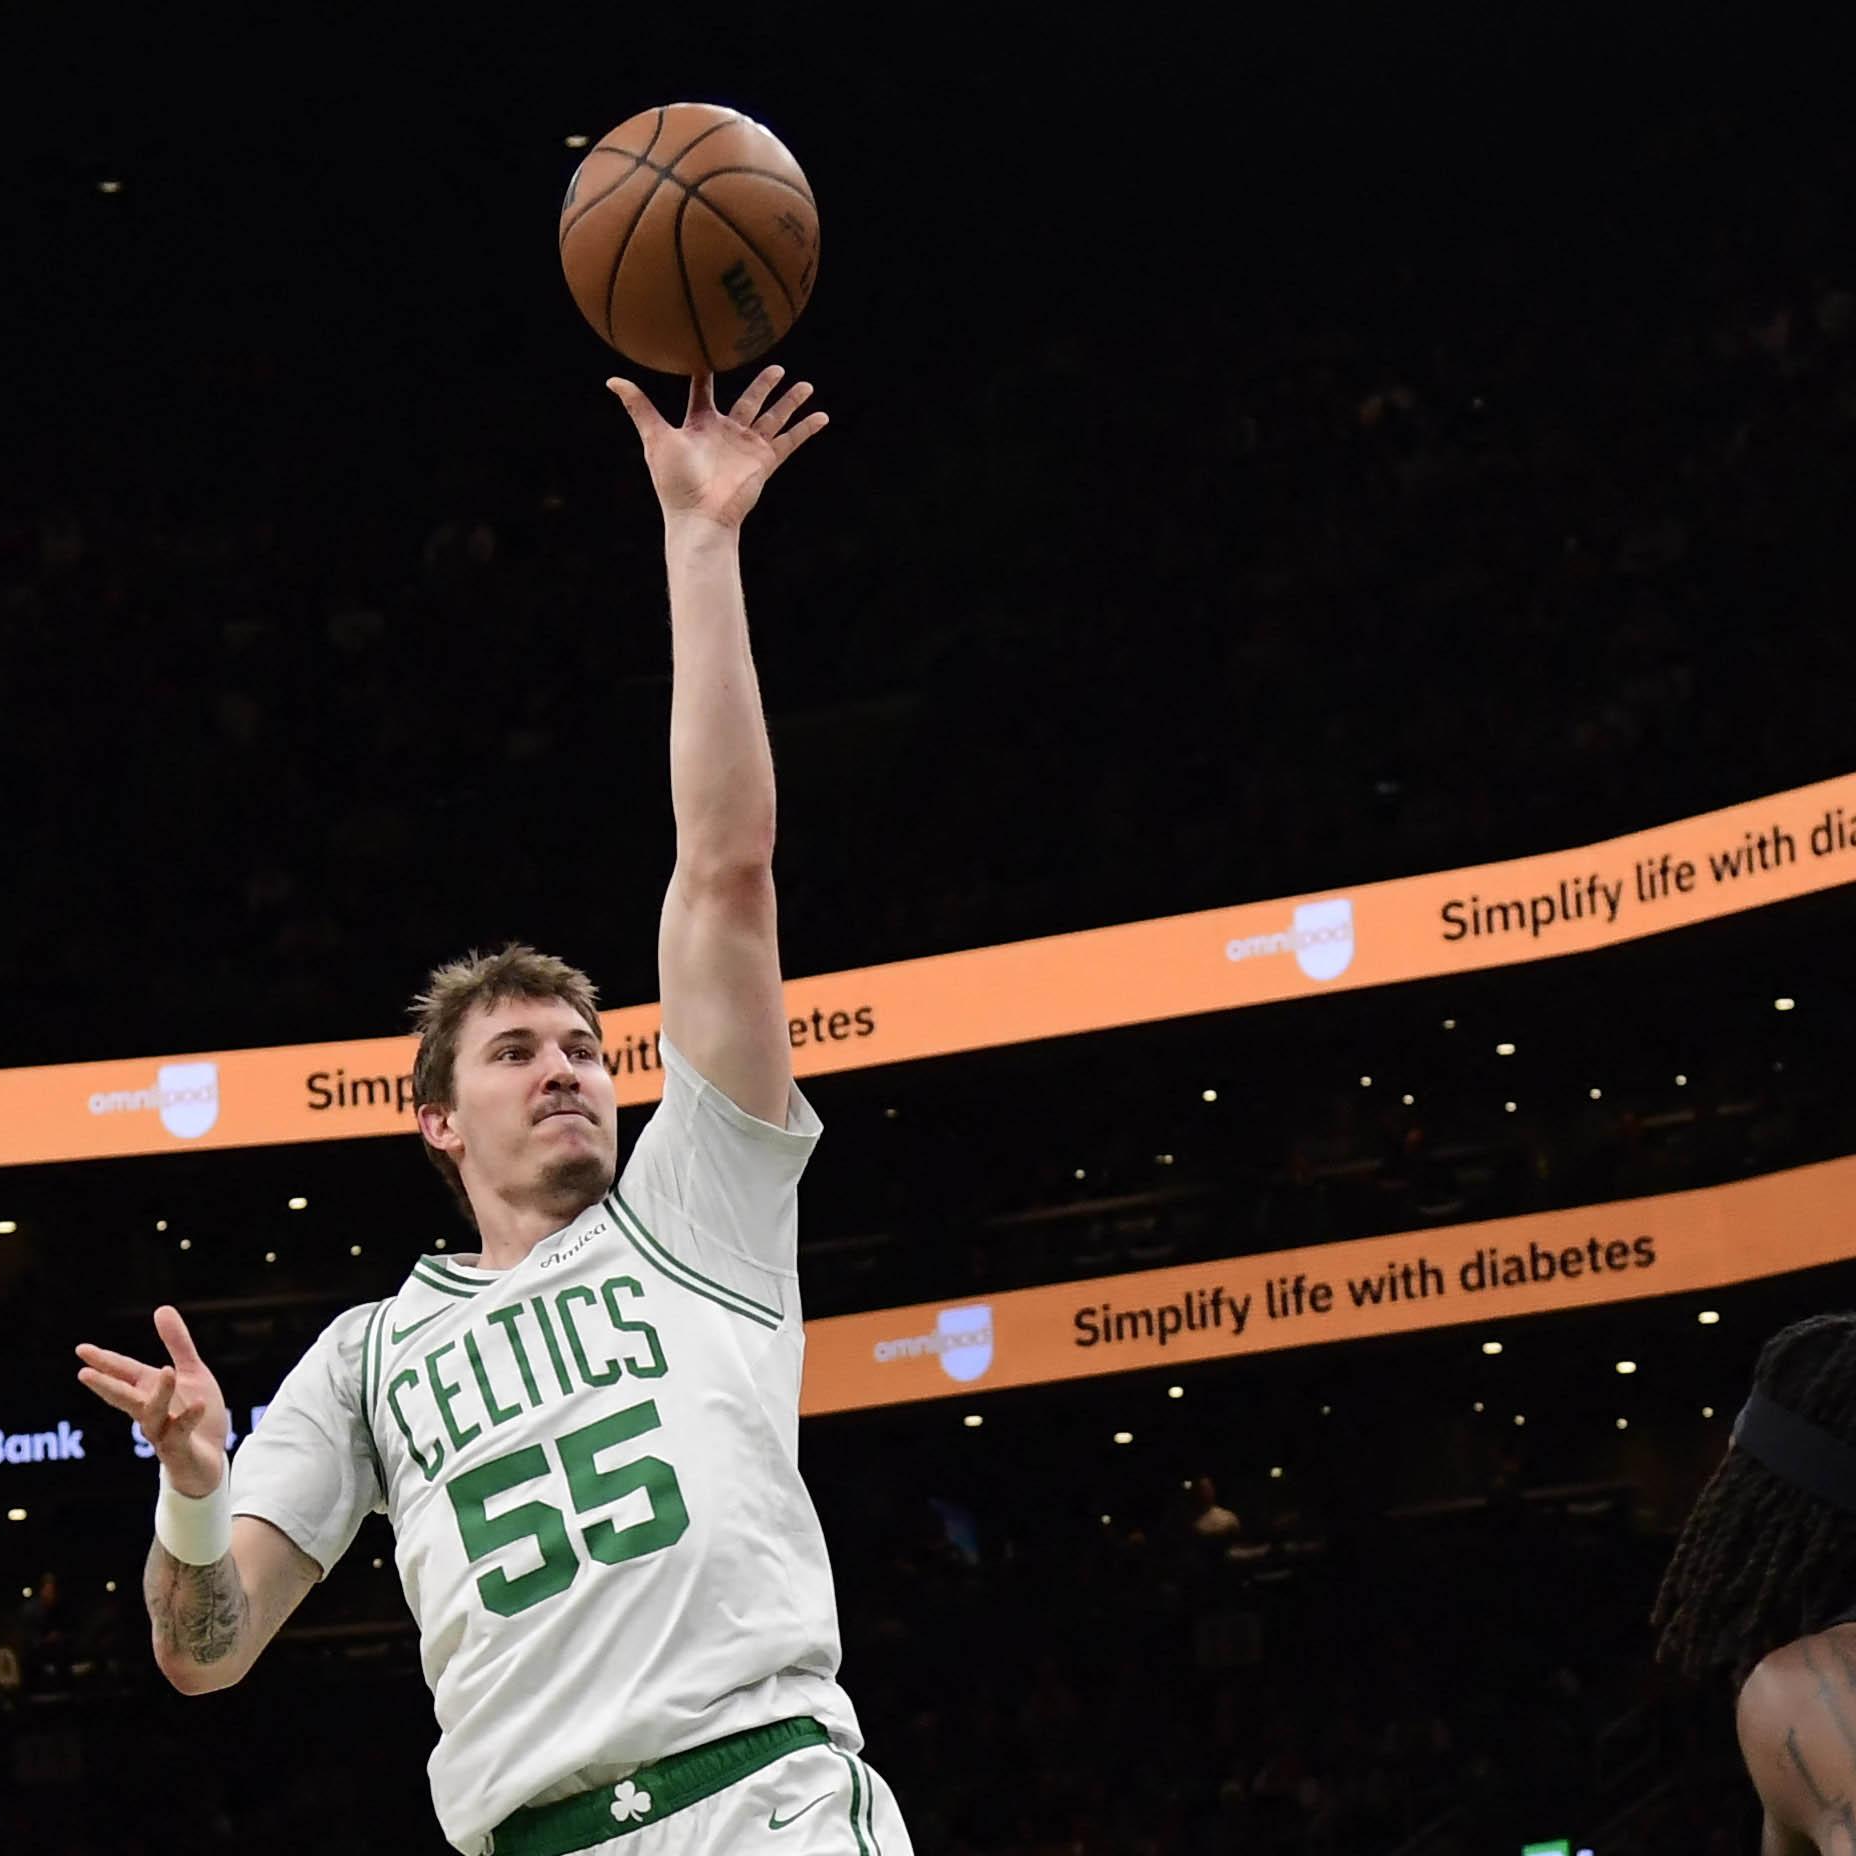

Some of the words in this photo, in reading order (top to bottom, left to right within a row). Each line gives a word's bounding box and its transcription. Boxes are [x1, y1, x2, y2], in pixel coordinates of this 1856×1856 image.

[1442, 874, 1622, 941] Simplify
[1636, 855, 1695, 903] life
[1710, 826, 1795, 882] with
[307, 1069, 415, 1114] Simp
[789, 1007, 874, 1048] etes
[541, 1222, 606, 1268] Amica
[1074, 1287, 1251, 1347] Simplify
[1266, 1274, 1333, 1319] life
[1348, 1258, 1444, 1308] with
[1459, 1236, 1656, 1292] diabetes
[387, 1275, 669, 1482] CELTICS
[446, 1399, 690, 1618] 55
